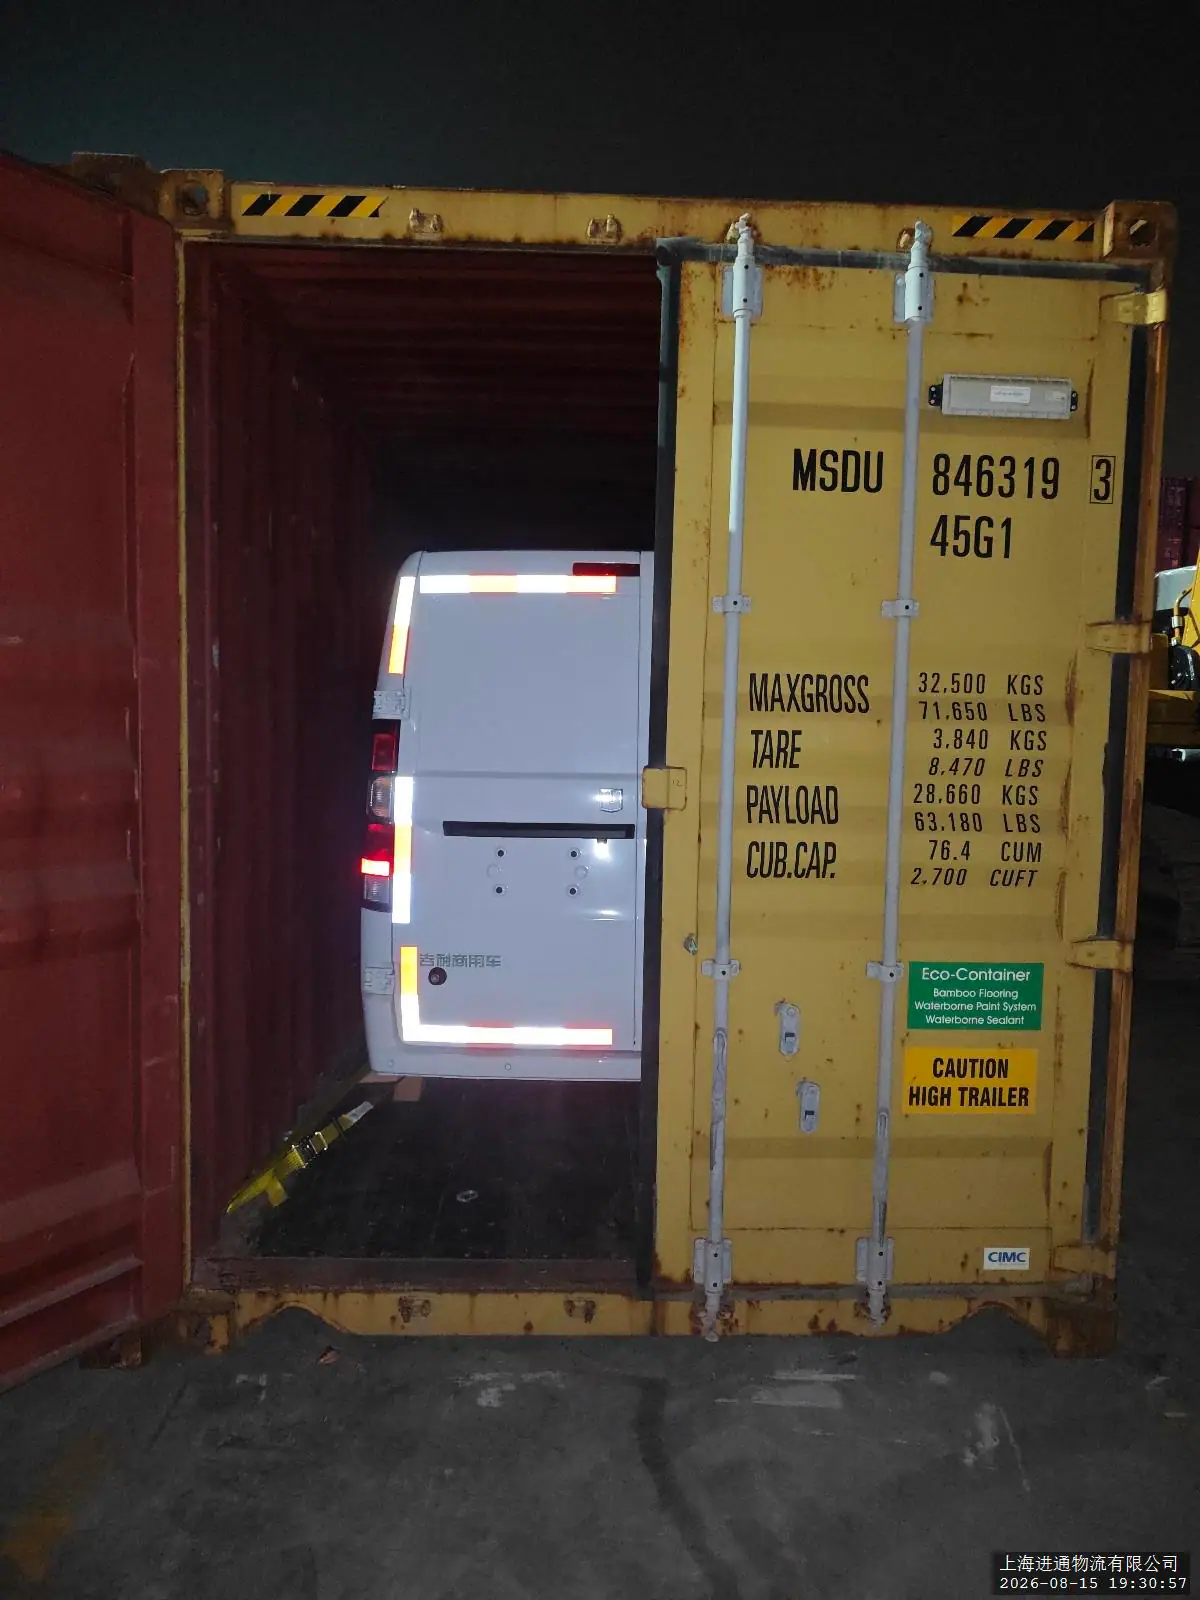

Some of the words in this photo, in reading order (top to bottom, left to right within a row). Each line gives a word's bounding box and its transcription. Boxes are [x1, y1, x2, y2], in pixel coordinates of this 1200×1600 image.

[792, 448, 883, 493] MSDU
[932, 453, 1060, 500] 846319
[1093, 458, 1112, 501] 3
[930, 515, 1012, 559] 45G1
[749, 673, 869, 714] MAXGROSS
[1007, 674, 1043, 695] KGS
[1008, 703, 1046, 722] LBS
[751, 730, 802, 769] TARE
[1010, 730, 1047, 751] KGS
[1005, 759, 1044, 778] LBS
[747, 785, 839, 825] PAYLOAD
[1002, 785, 1039, 806] KGS
[1003, 813, 1041, 834] LBS
[746, 841, 837, 879] CUB.CAP.
[928, 840, 970, 861] 76.4
[1001, 841, 1042, 863] CUM
[989, 869, 1038, 888] CUFT
[921, 967, 1031, 982] Eco-Container
[933, 987, 976, 998] Bamboo
[979, 988, 1019, 1001] Flooring
[914, 1001, 974, 1011] Waterborne
[976, 1001, 1000, 1011] Paint
[1002, 1002, 1037, 1013] System
[925, 1014, 985, 1025] Waterborne
[987, 1015, 1025, 1025] Sealant
[932, 1057, 1009, 1079] CAUTION
[908, 1086, 952, 1107] HIGH
[957, 1086, 1030, 1107] TRAILER
[988, 1252, 1027, 1262] CIMC
